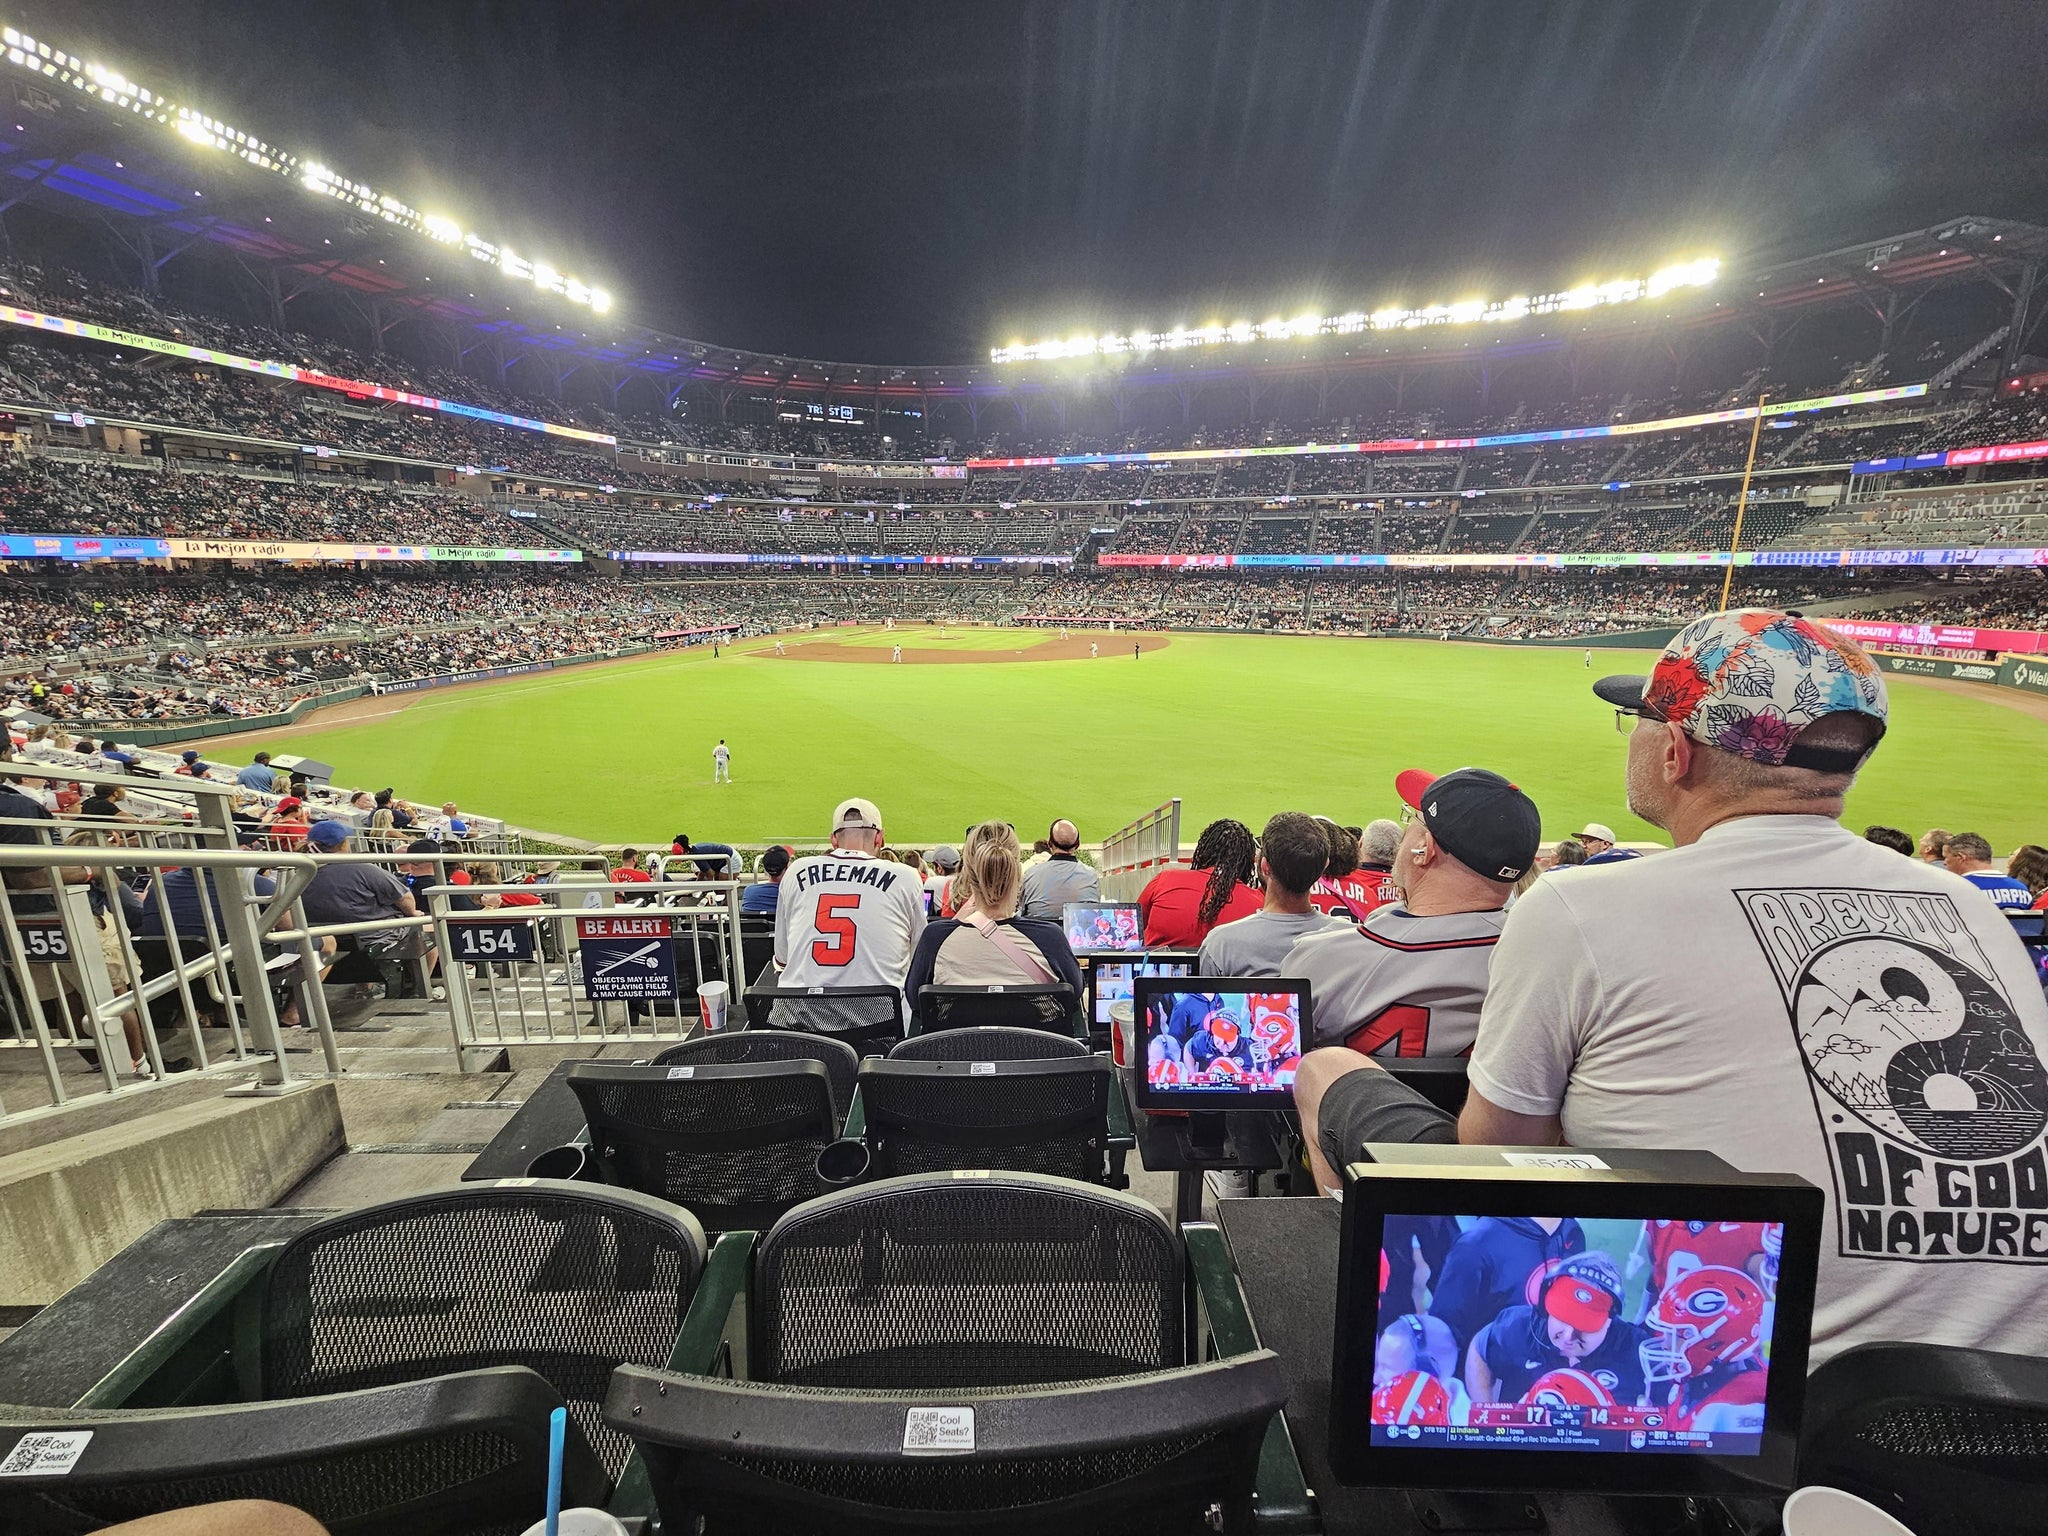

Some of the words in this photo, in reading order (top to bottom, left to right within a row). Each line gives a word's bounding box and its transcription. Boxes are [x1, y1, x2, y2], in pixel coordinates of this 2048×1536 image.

[112, 331, 144, 345] Mejor
[205, 542, 247, 556] Mejor
[252, 544, 285, 555] radio
[448, 548, 473, 558] Mejor
[476, 549, 496, 558] radio
[1855, 626, 1892, 637] SOUTH
[513, 665, 529, 673] DELTA
[1906, 660, 1936, 668] TYM
[458, 672, 477, 681] DELTA
[393, 681, 416, 690] DELTA
[795, 863, 897, 892] FREEMAN
[1345, 882, 1368, 905] JR.
[584, 920, 607, 935] BE
[612, 919, 662, 934] ALERT
[812, 893, 861, 967] 5
[24, 930, 68, 955] 55
[462, 929, 516, 954] 154
[591, 976, 626, 984] OBJECTS
[645, 975, 669, 983] LEAVE
[1834, 1132, 1925, 1207] OF
[1934, 1136, 2048, 1210] GOO
[1848, 1208, 2048, 1257] NATURE
[1579, 1266, 1612, 1286] DELTA
[940, 1415, 961, 1425] Cool
[1527, 1406, 1545, 1422] 17
[1591, 1408, 1608, 1425] 14
[939, 1427, 970, 1436] Seats?
[50, 1439, 75, 1449] Cool
[1486, 1435, 1512, 1443] Go-ahead
[1572, 1438, 1600, 1446] remaining
[41, 1451, 77, 1462] Seats?
